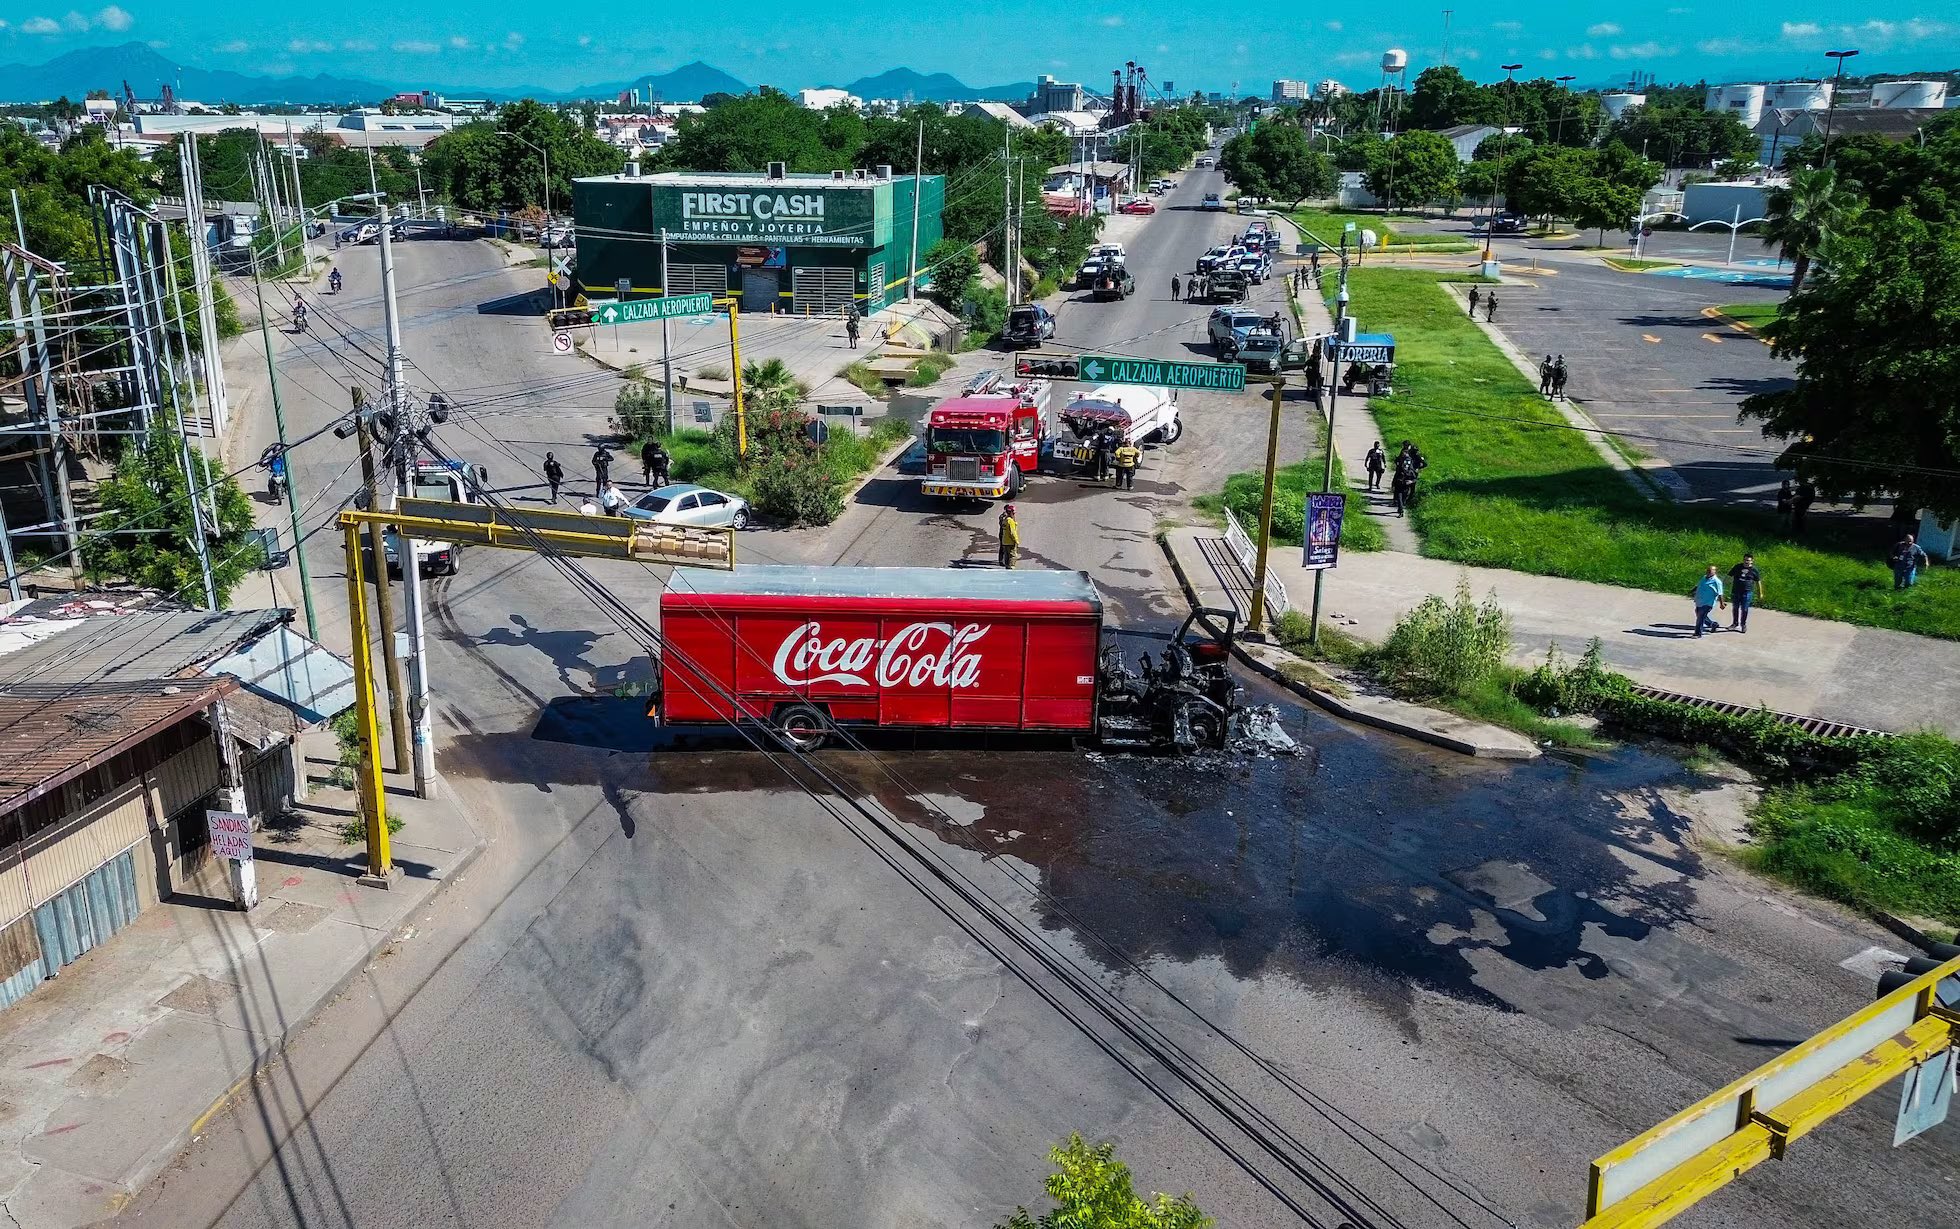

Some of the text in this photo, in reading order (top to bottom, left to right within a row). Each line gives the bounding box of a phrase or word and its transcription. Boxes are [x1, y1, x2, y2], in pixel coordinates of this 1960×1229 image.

[682, 192, 825, 220] FIRST CASH
[683, 220, 823, 234] EMPEÑO Y JOYERIA
[665, 232, 865, 244] OMPUTADORAS CELULARES PANTALLAS HERRAMIENTAS
[622, 296, 710, 321] CALZADA AEROPUERTO
[1333, 346, 1389, 362] LORERIA
[1111, 361, 1241, 388] CALZADA AEROPUERTO
[773, 621, 991, 688] Coca-Cola
[210, 816, 249, 834] SANDIAS
[212, 833, 249, 849] HELADAS
